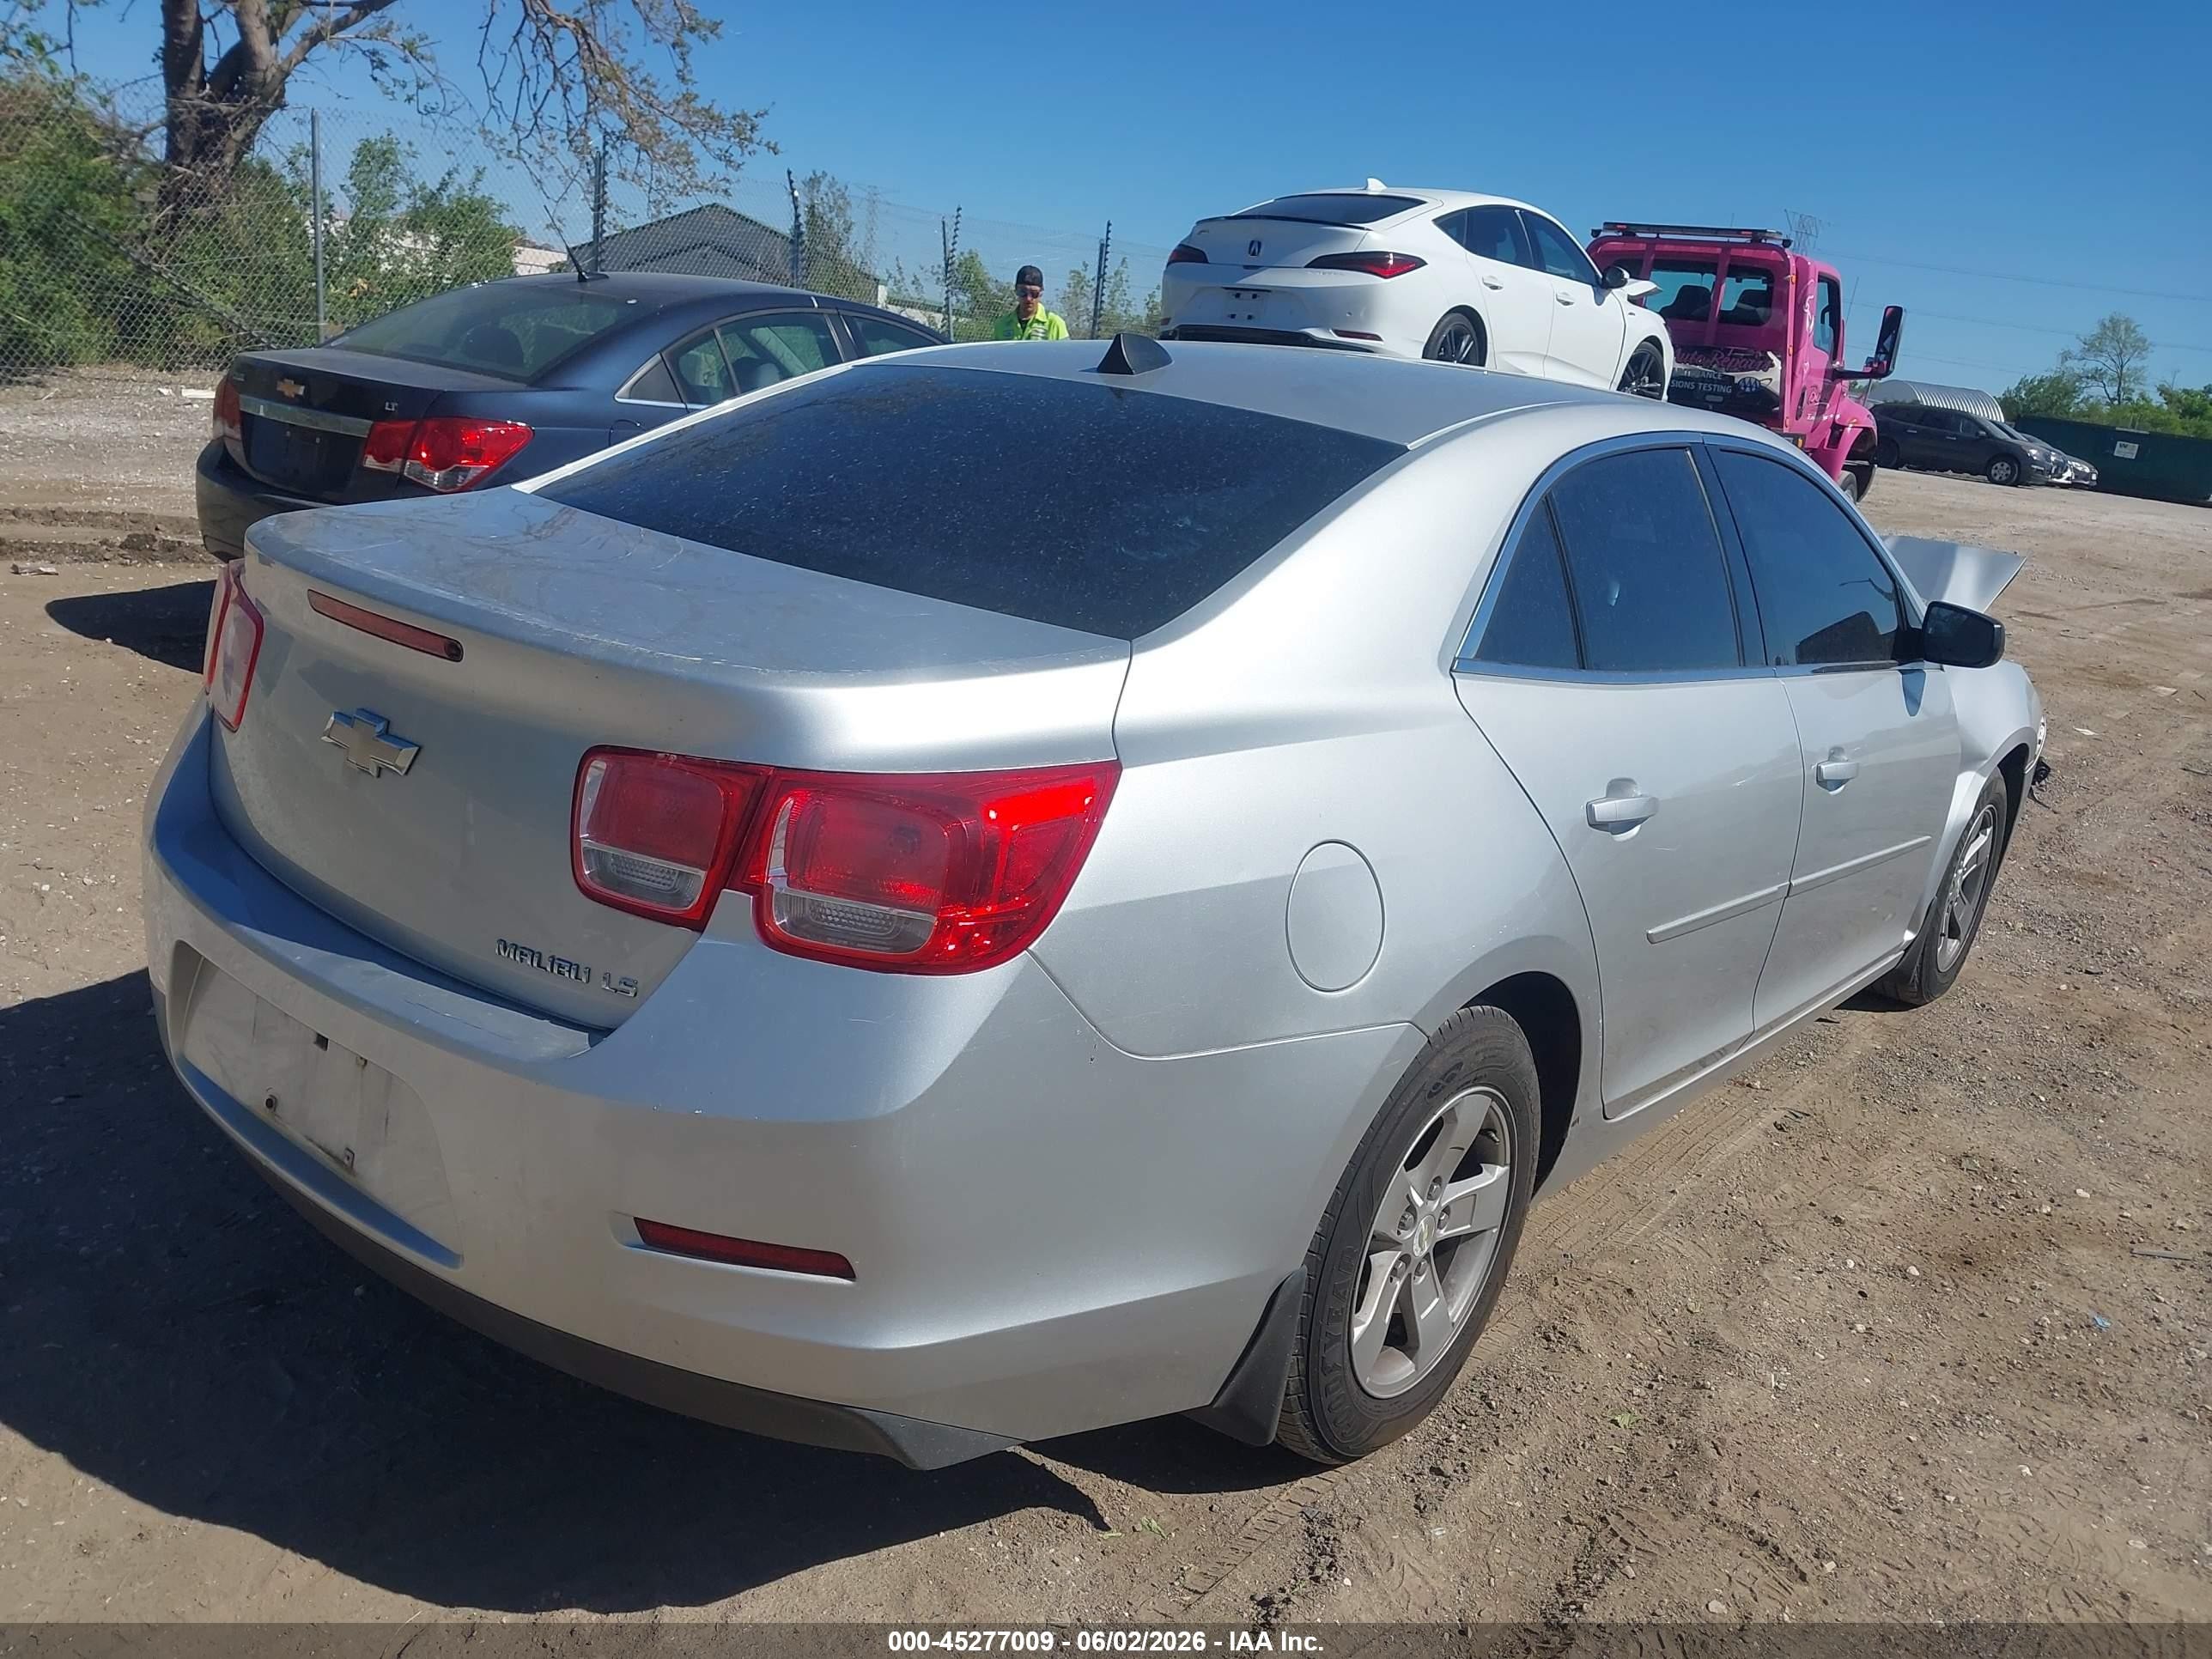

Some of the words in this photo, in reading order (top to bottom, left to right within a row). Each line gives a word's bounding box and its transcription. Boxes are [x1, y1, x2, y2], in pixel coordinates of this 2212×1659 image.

[1698, 382, 1732, 393] TESTING
[495, 938, 591, 984] MALIBU
[602, 971, 638, 998] LS
